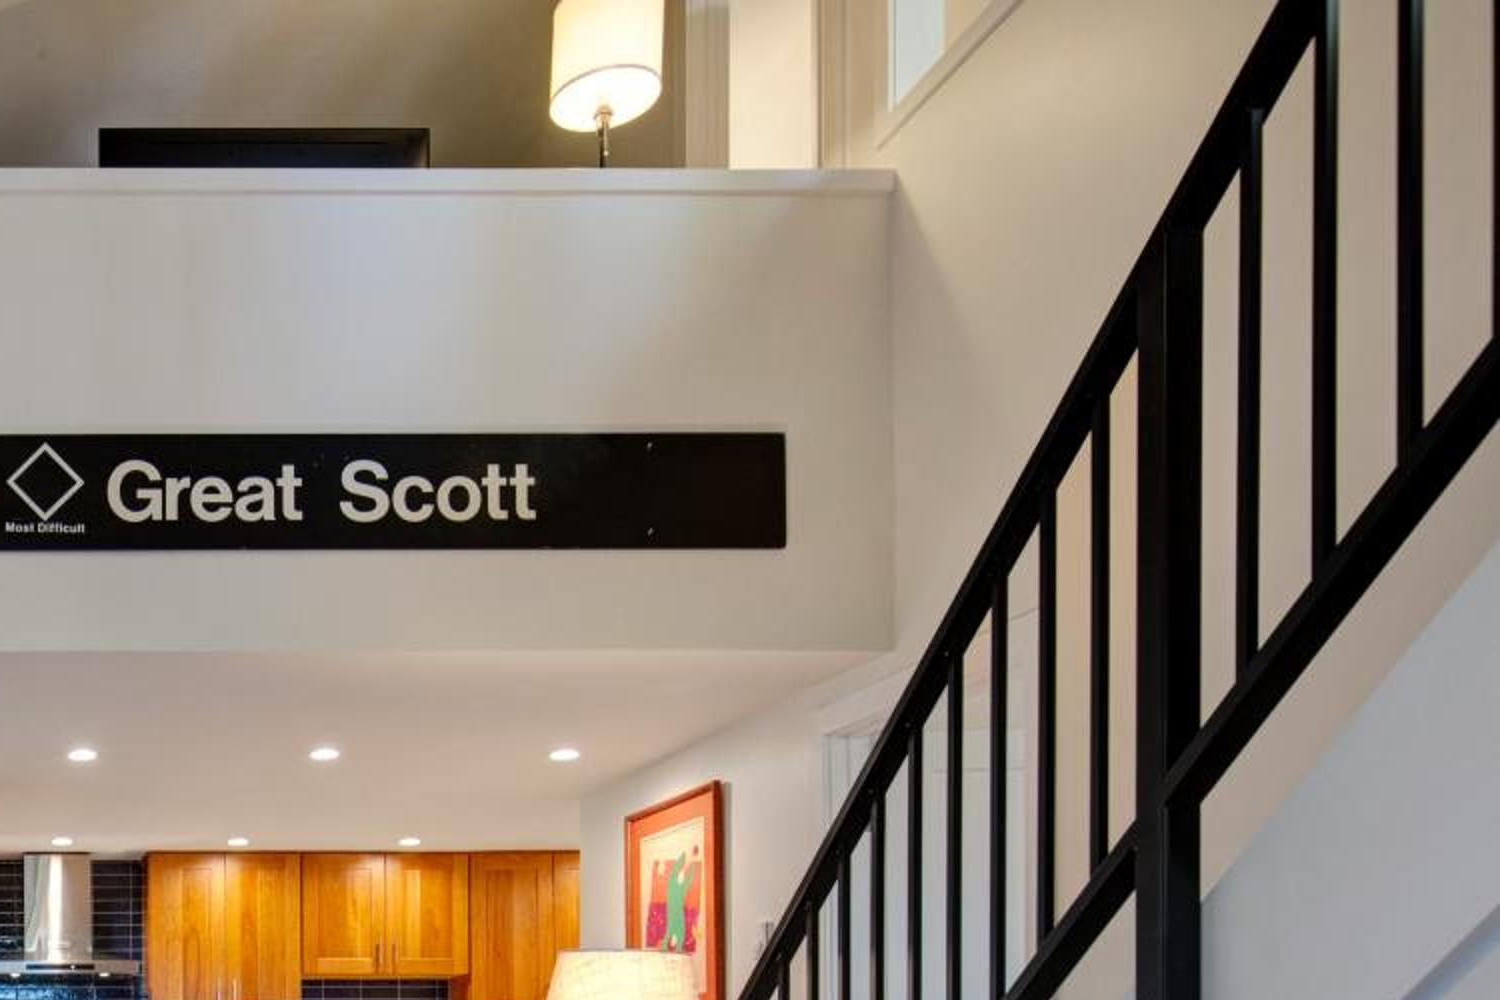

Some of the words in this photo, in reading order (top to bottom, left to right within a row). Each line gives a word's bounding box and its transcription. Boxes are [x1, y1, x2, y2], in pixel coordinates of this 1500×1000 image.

[106, 458, 304, 523] Great
[338, 458, 538, 523] Scott
[4, 521, 35, 534] Most
[37, 522, 86, 535] Difficult
